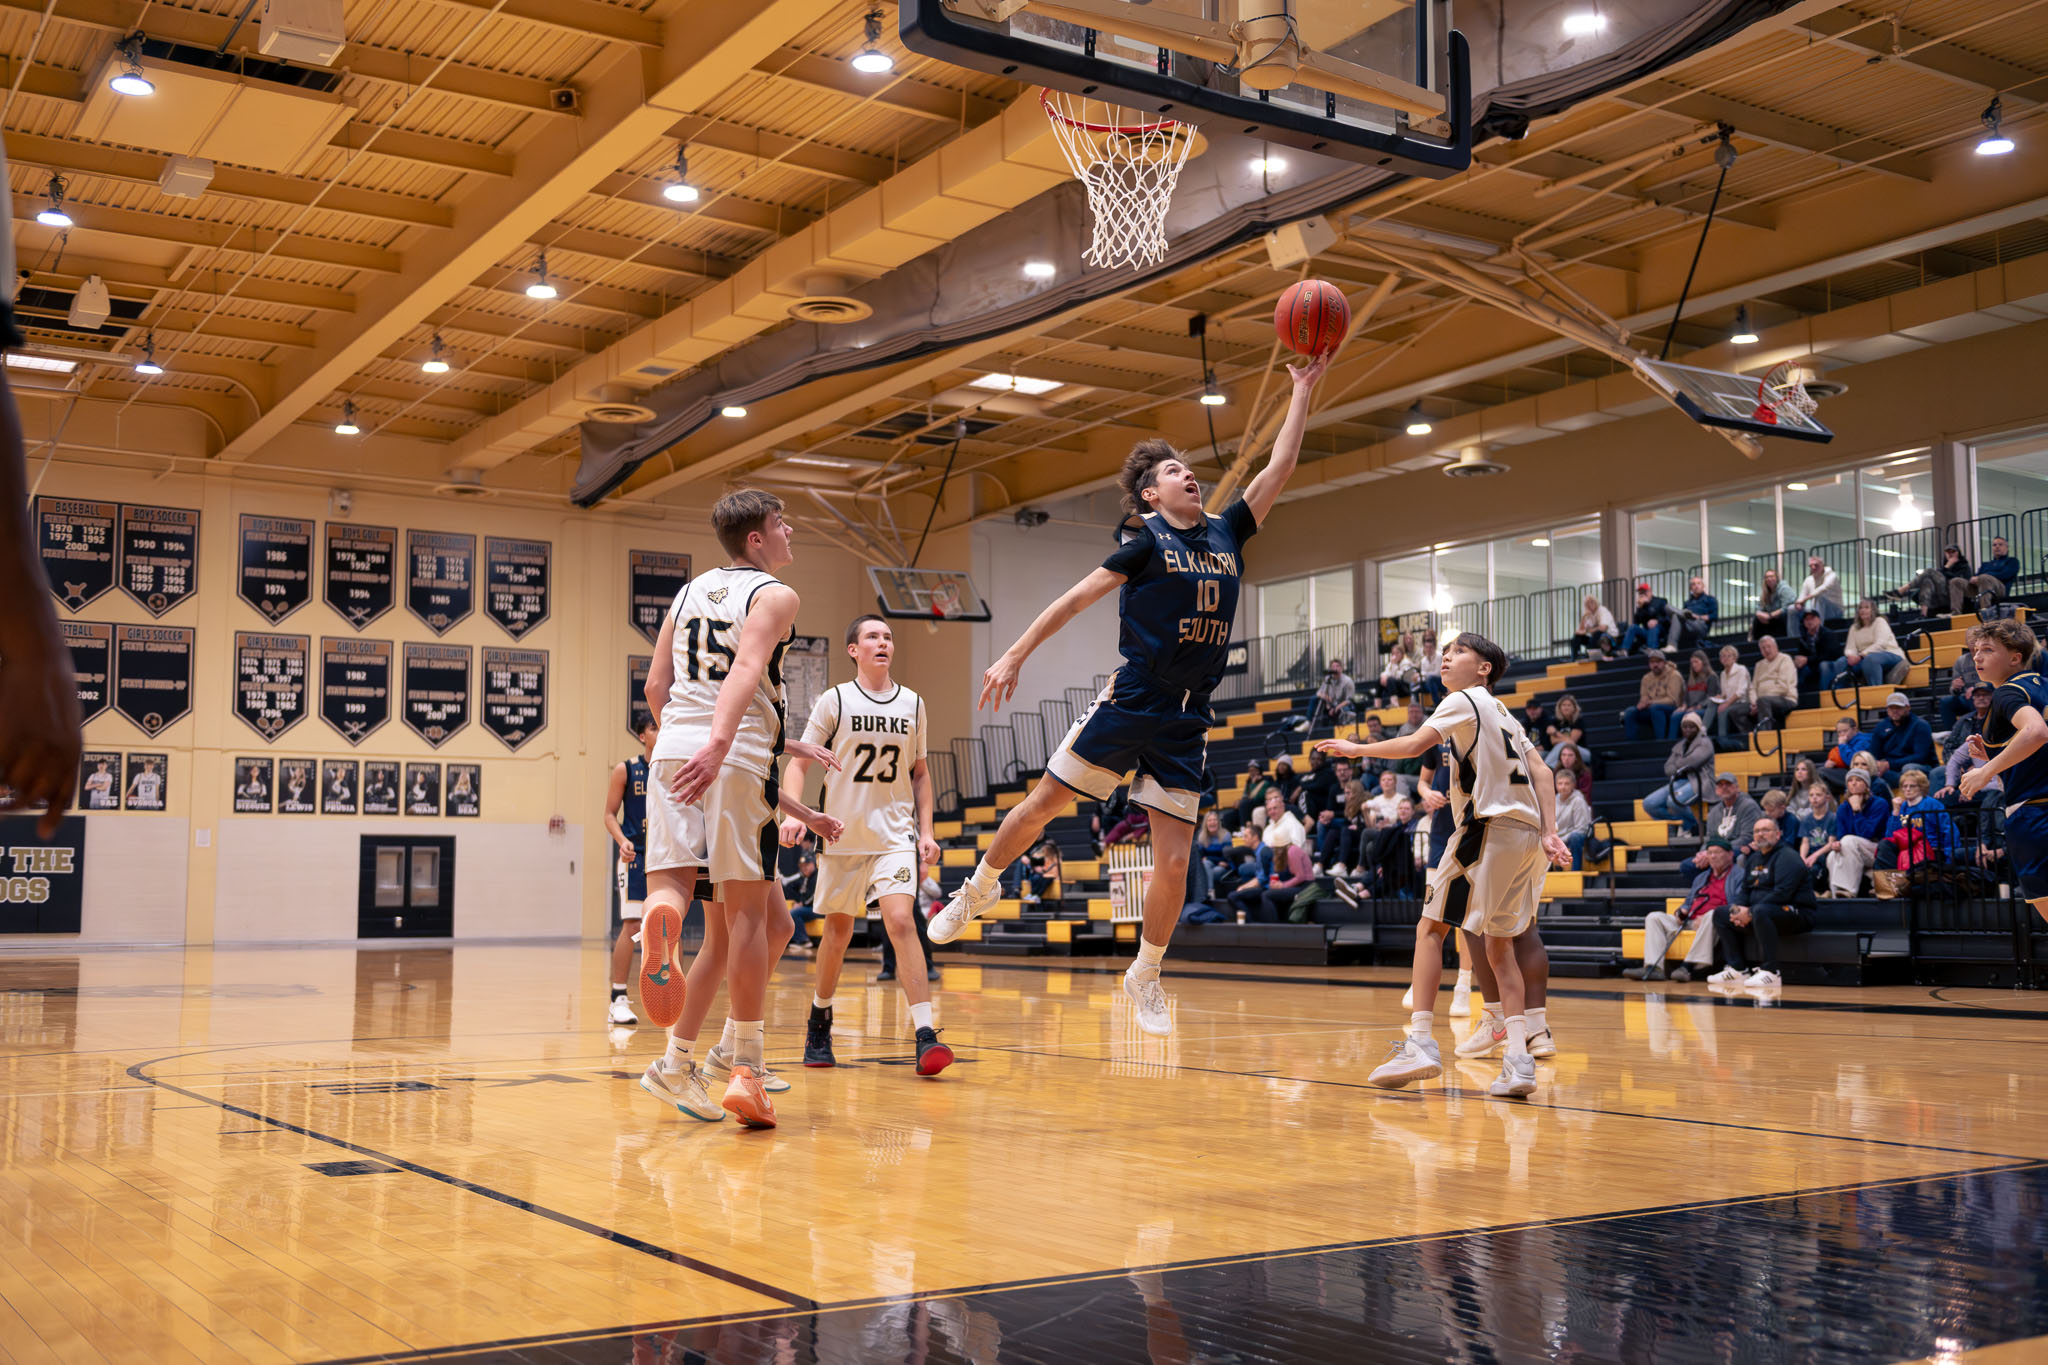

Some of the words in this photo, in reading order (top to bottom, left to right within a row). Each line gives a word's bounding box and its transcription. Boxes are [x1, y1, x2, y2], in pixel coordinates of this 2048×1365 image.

[56, 502, 100, 516] BASEBALL
[134, 508, 154, 520] BOYS
[158, 511, 187, 522] SOCCER
[49, 523, 73, 533] 1970
[83, 526, 106, 536] 1975
[275, 521, 302, 533] TENNIS
[49, 532, 73, 541] 1979
[82, 534, 105, 544] 1992
[65, 541, 89, 551] 2000
[133, 539, 156, 549] 1990
[163, 541, 185, 551] 1994
[1163, 549, 1238, 577] ELKHORN
[131, 573, 154, 582] 1995
[164, 575, 185, 585] 1996
[131, 582, 153, 592] 1997
[162, 584, 185, 594] 2002
[1195, 579, 1220, 612] 10
[60, 623, 93, 636] FTBALL
[127, 628, 150, 640] GIRLS
[153, 629, 183, 641] SOCCER
[1178, 617, 1230, 647] SOUTH
[247, 636, 268, 648] GIRLS
[272, 637, 298, 649] TENNIS
[684, 616, 736, 681] 15
[851, 715, 910, 735] BURKE
[853, 743, 901, 784] 23
[9, 846, 75, 874] THE
